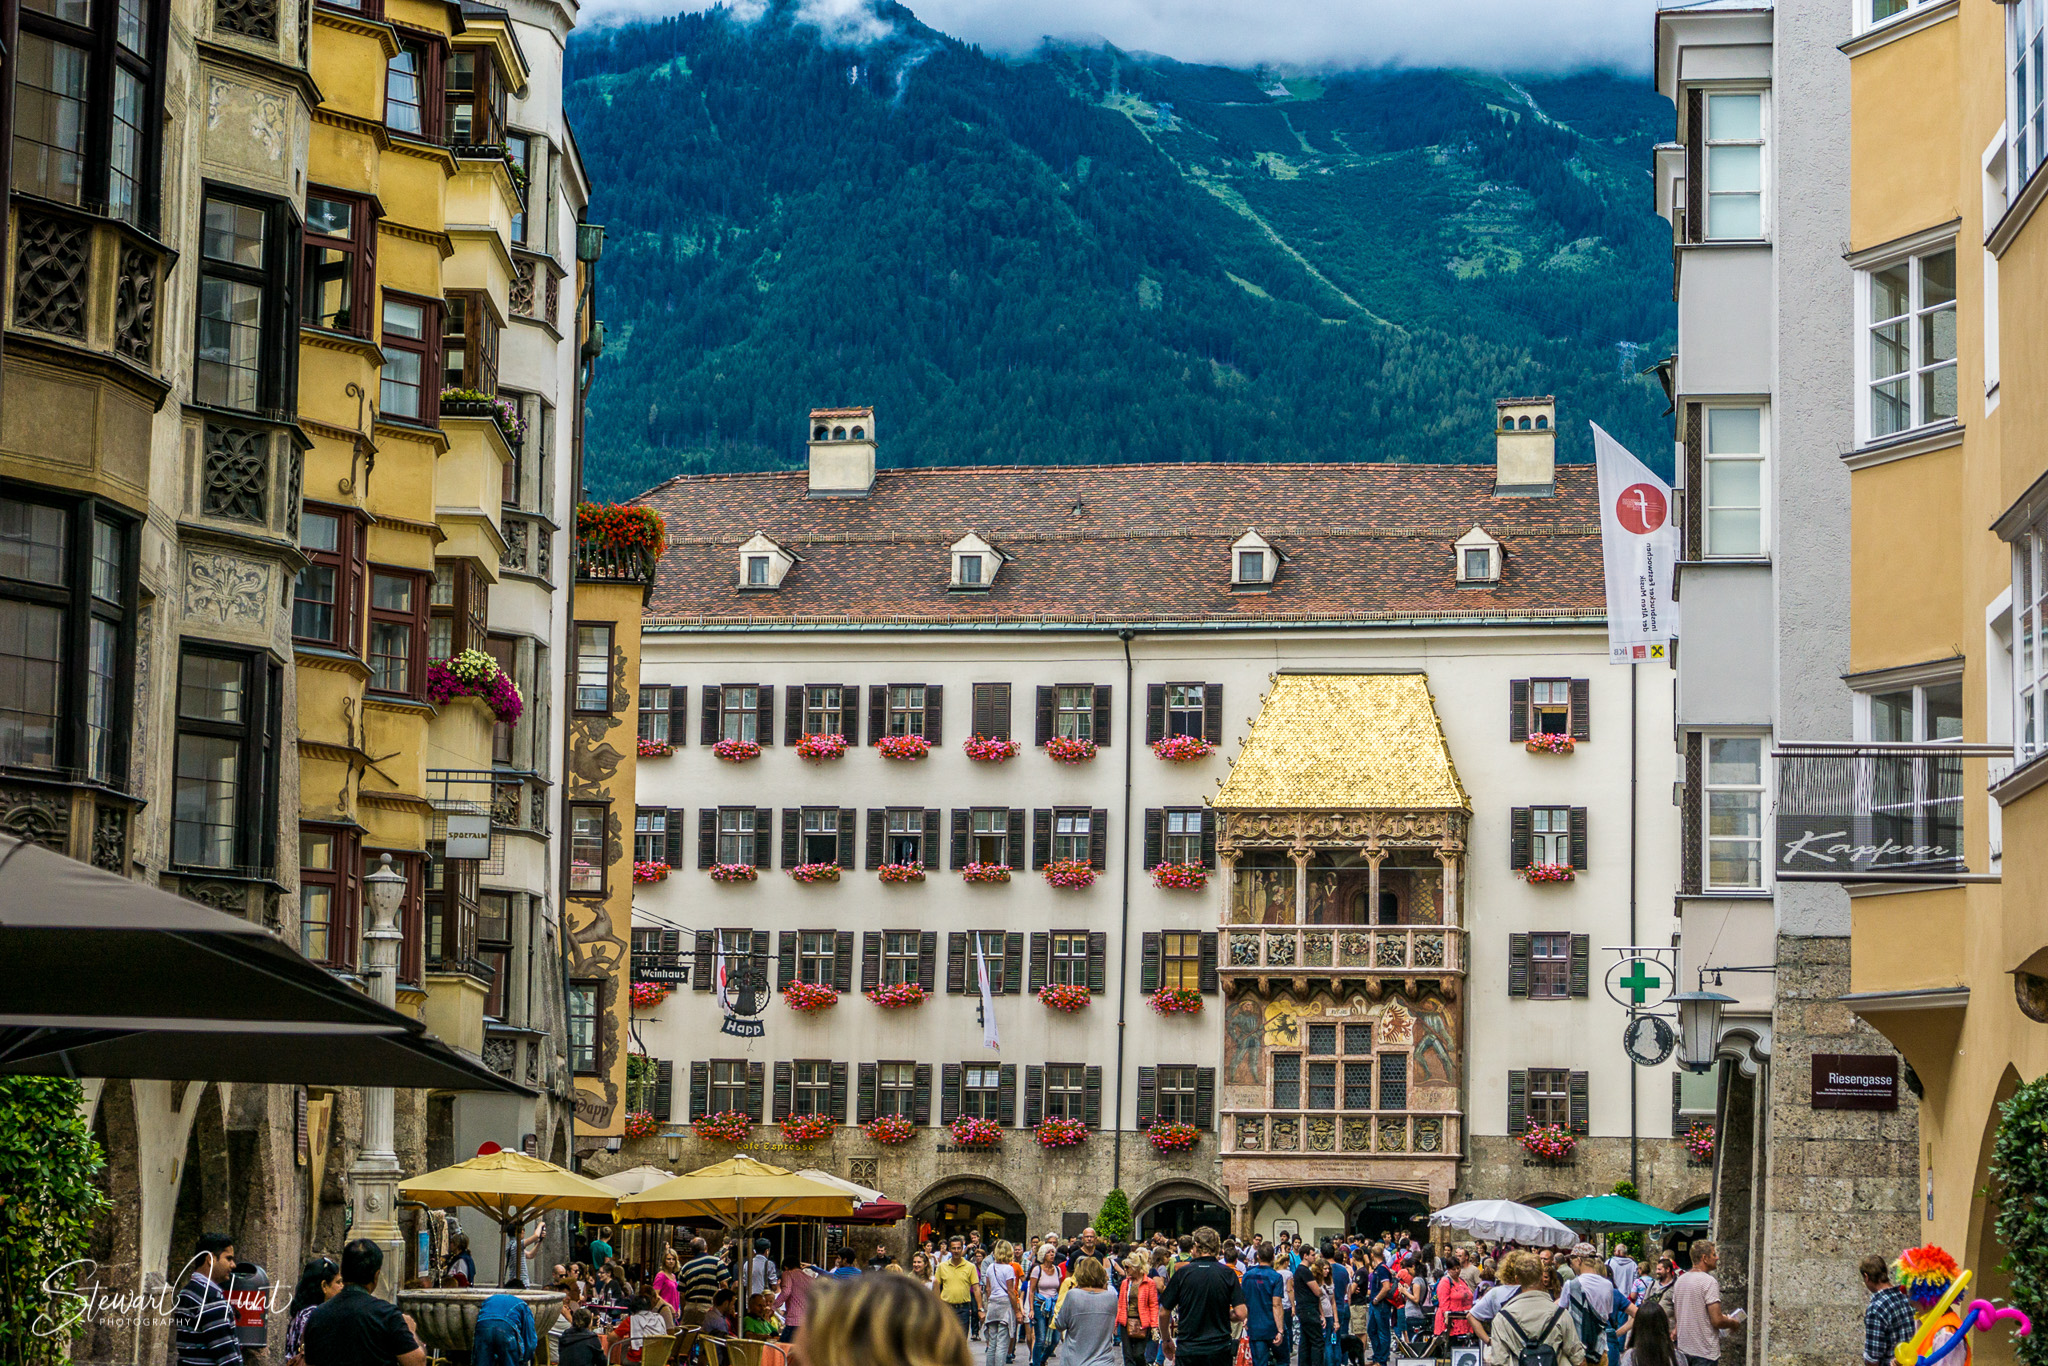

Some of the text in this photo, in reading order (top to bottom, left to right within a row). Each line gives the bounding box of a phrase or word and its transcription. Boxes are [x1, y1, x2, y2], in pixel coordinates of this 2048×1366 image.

[1783, 831, 1949, 863] Kapferer
[641, 968, 686, 979] Weinhaus
[726, 1020, 761, 1036] Happ
[1828, 1072, 1893, 1087] Riesengasse
[763, 1141, 815, 1152] Espresso
